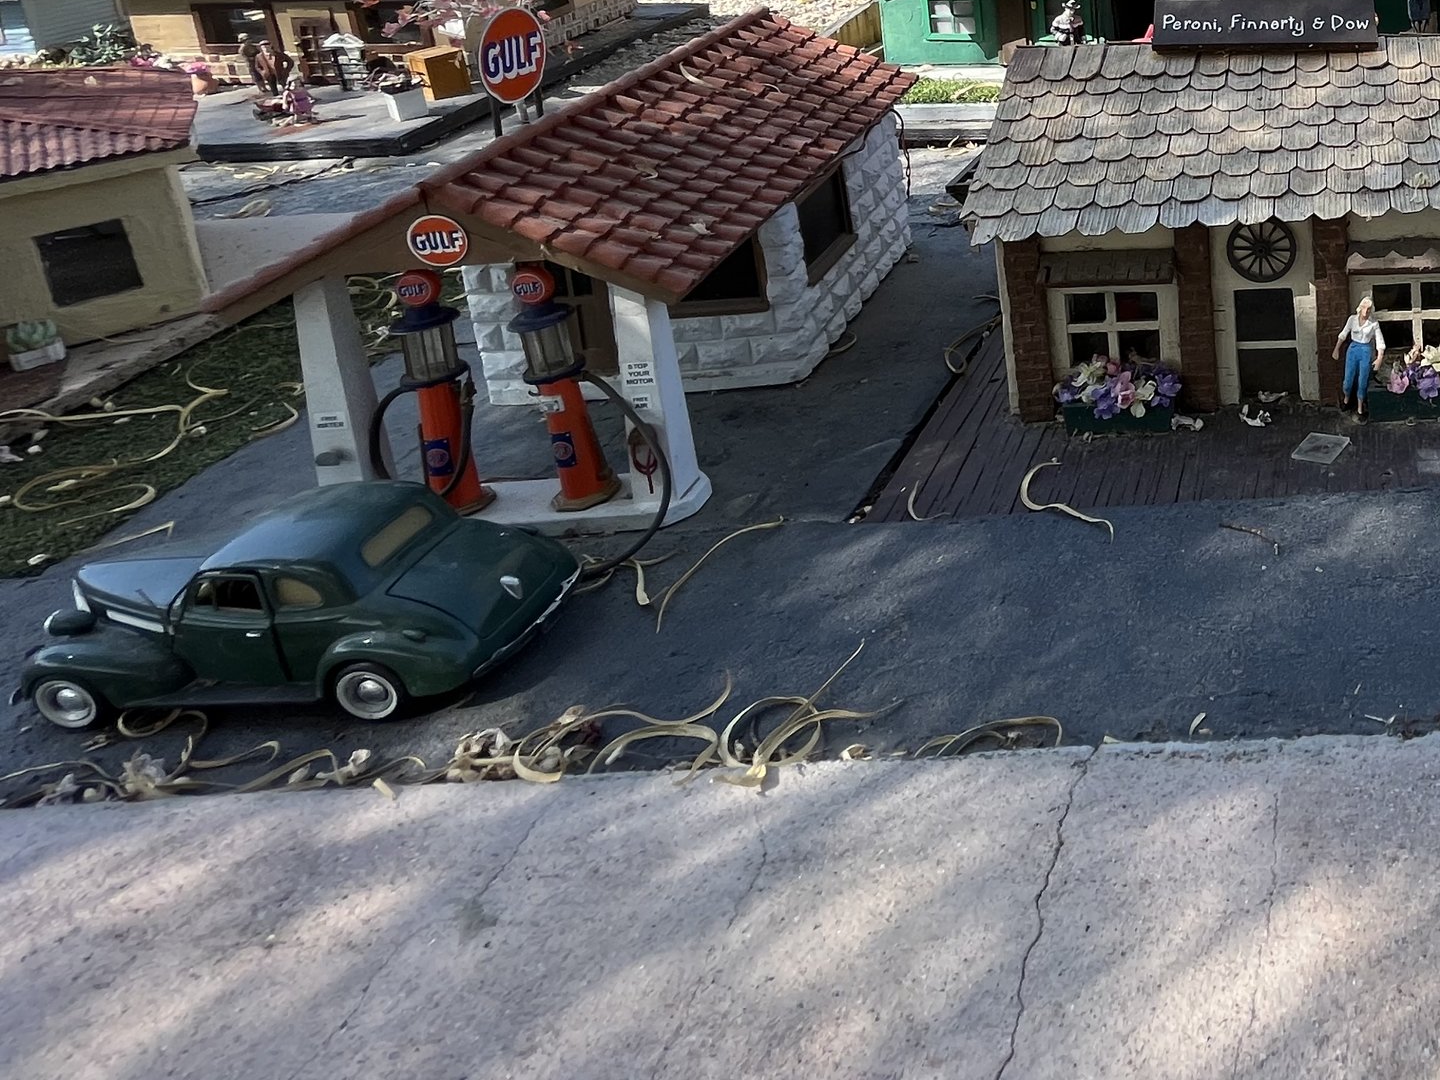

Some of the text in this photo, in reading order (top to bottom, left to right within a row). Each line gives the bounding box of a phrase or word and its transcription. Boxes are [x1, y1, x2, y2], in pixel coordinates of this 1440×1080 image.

[1162, 13, 1370, 36] Peroni, Finnerty & Dow
[483, 31, 541, 84] GULF
[412, 230, 463, 255] GULF
[400, 281, 427, 297] GULF
[514, 281, 542, 296] GULF
